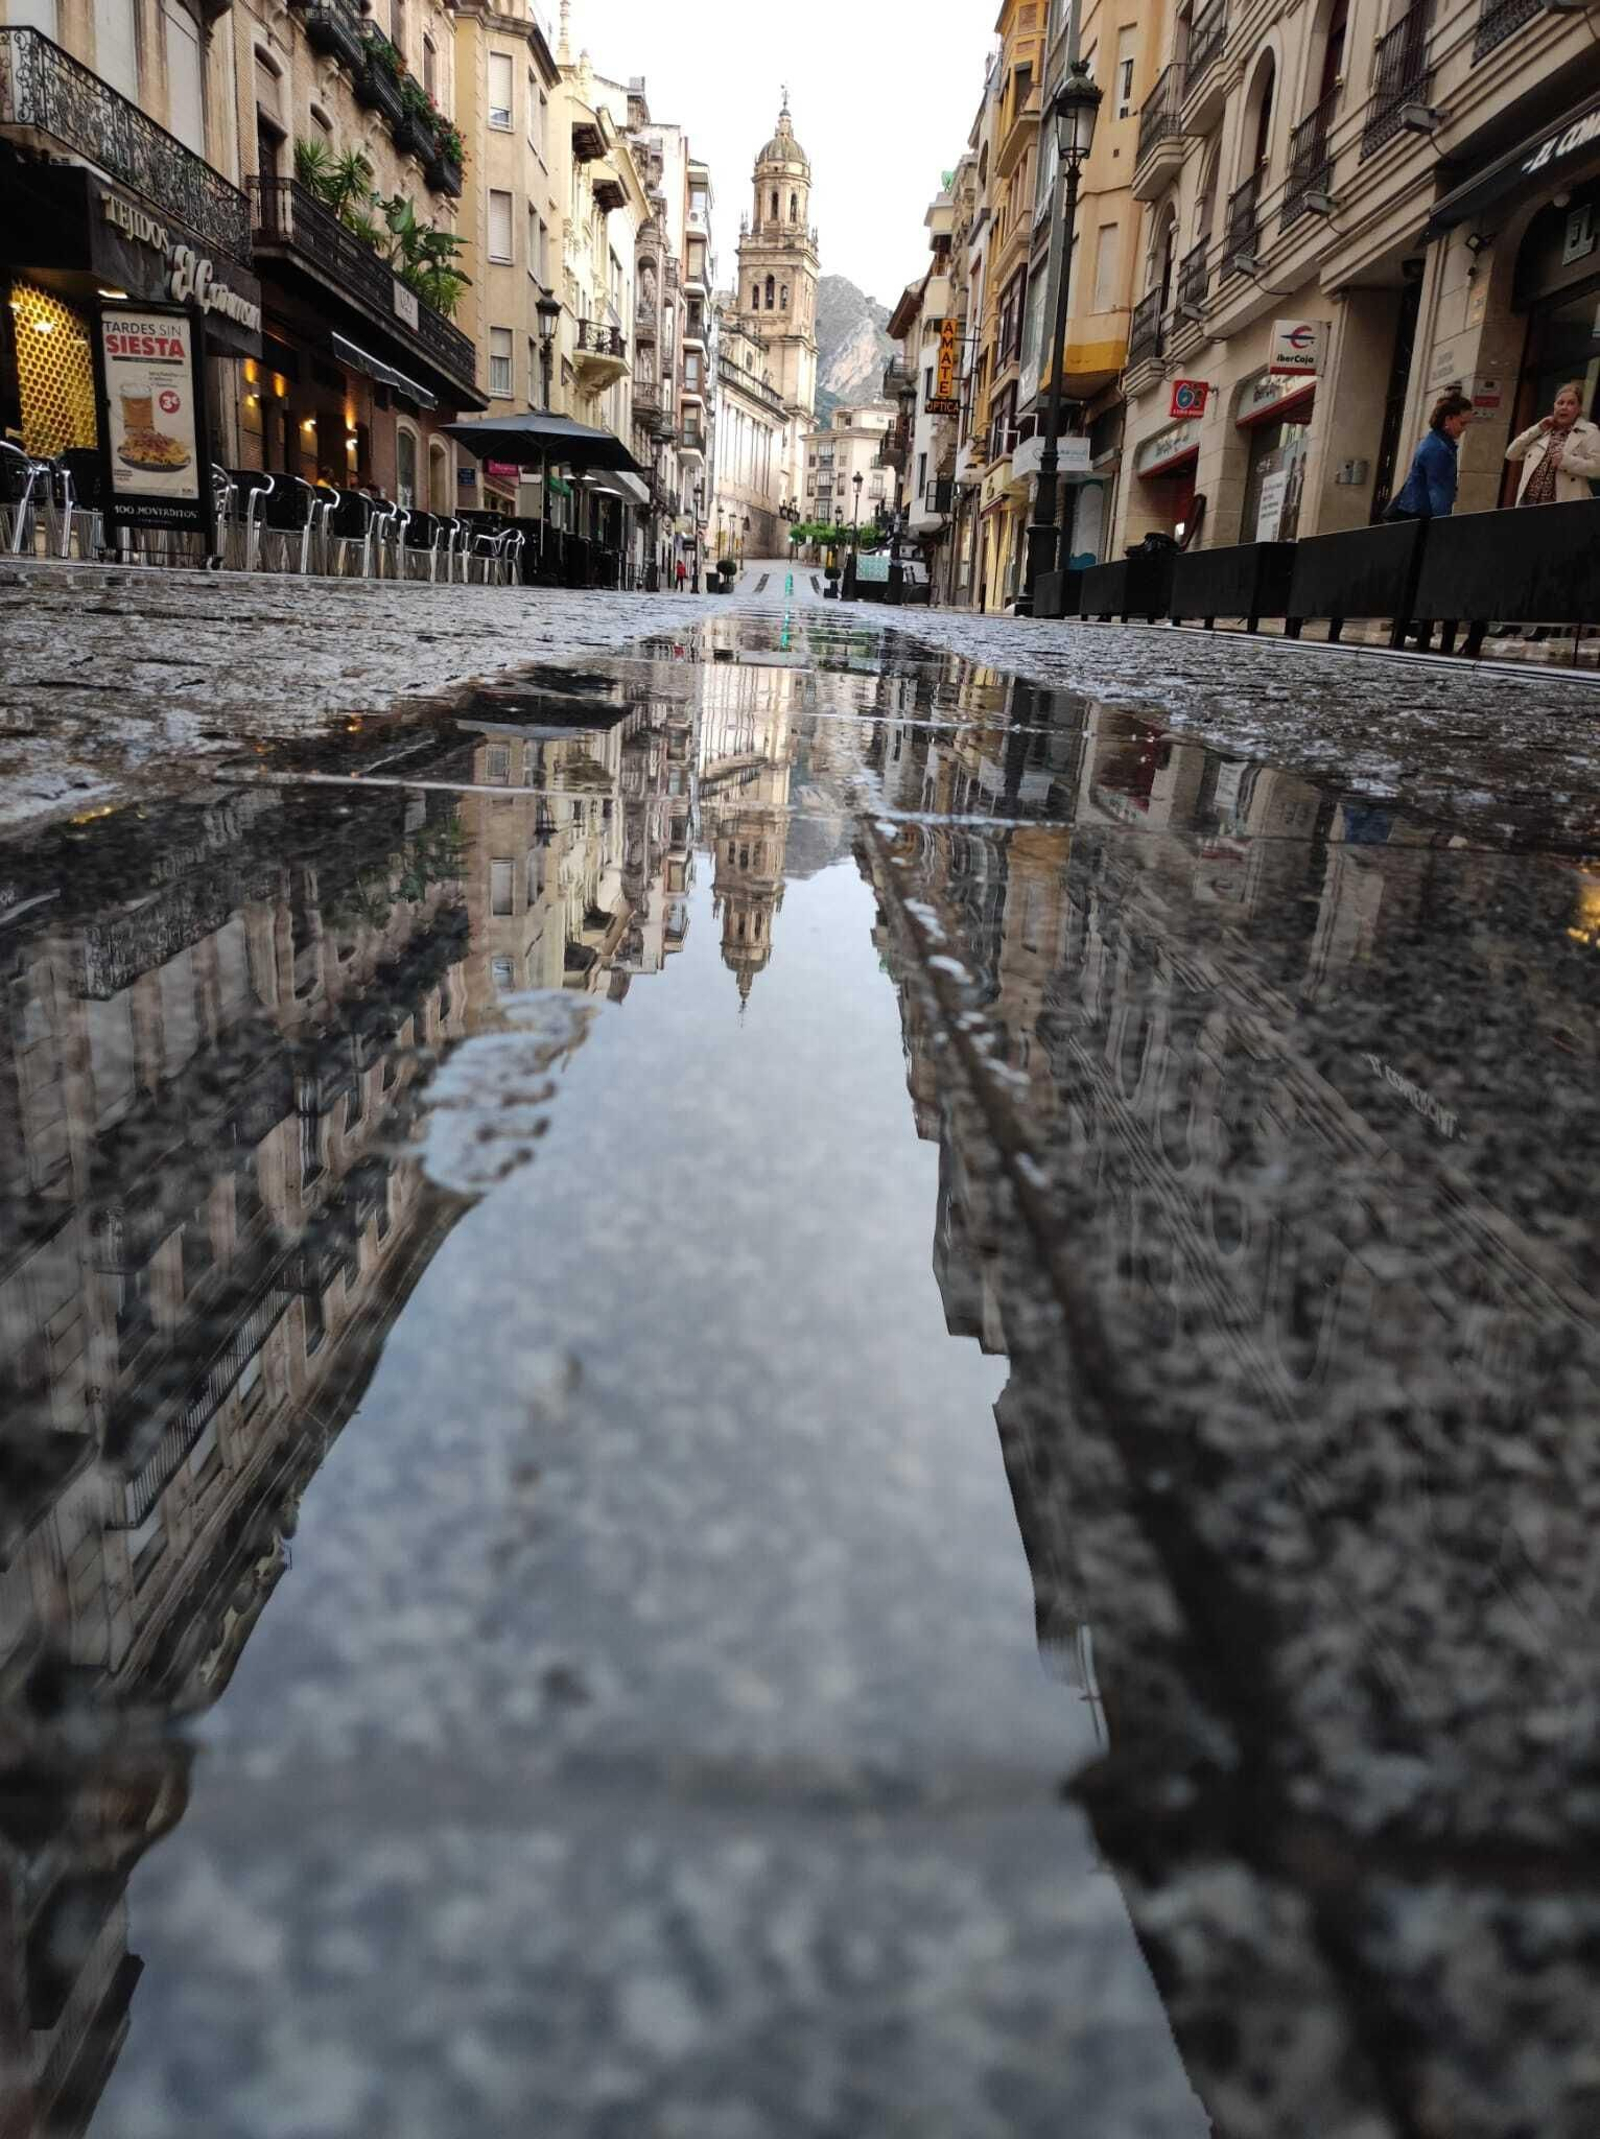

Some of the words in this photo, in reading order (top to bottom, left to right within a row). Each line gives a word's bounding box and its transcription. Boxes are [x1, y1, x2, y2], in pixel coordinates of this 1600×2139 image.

[102, 190, 169, 254] TEJIDOS
[102, 321, 156, 335] TARDES
[159, 324, 182, 337] SIN
[105, 333, 186, 358] SIESTA
[938, 321, 954, 395] AMATE
